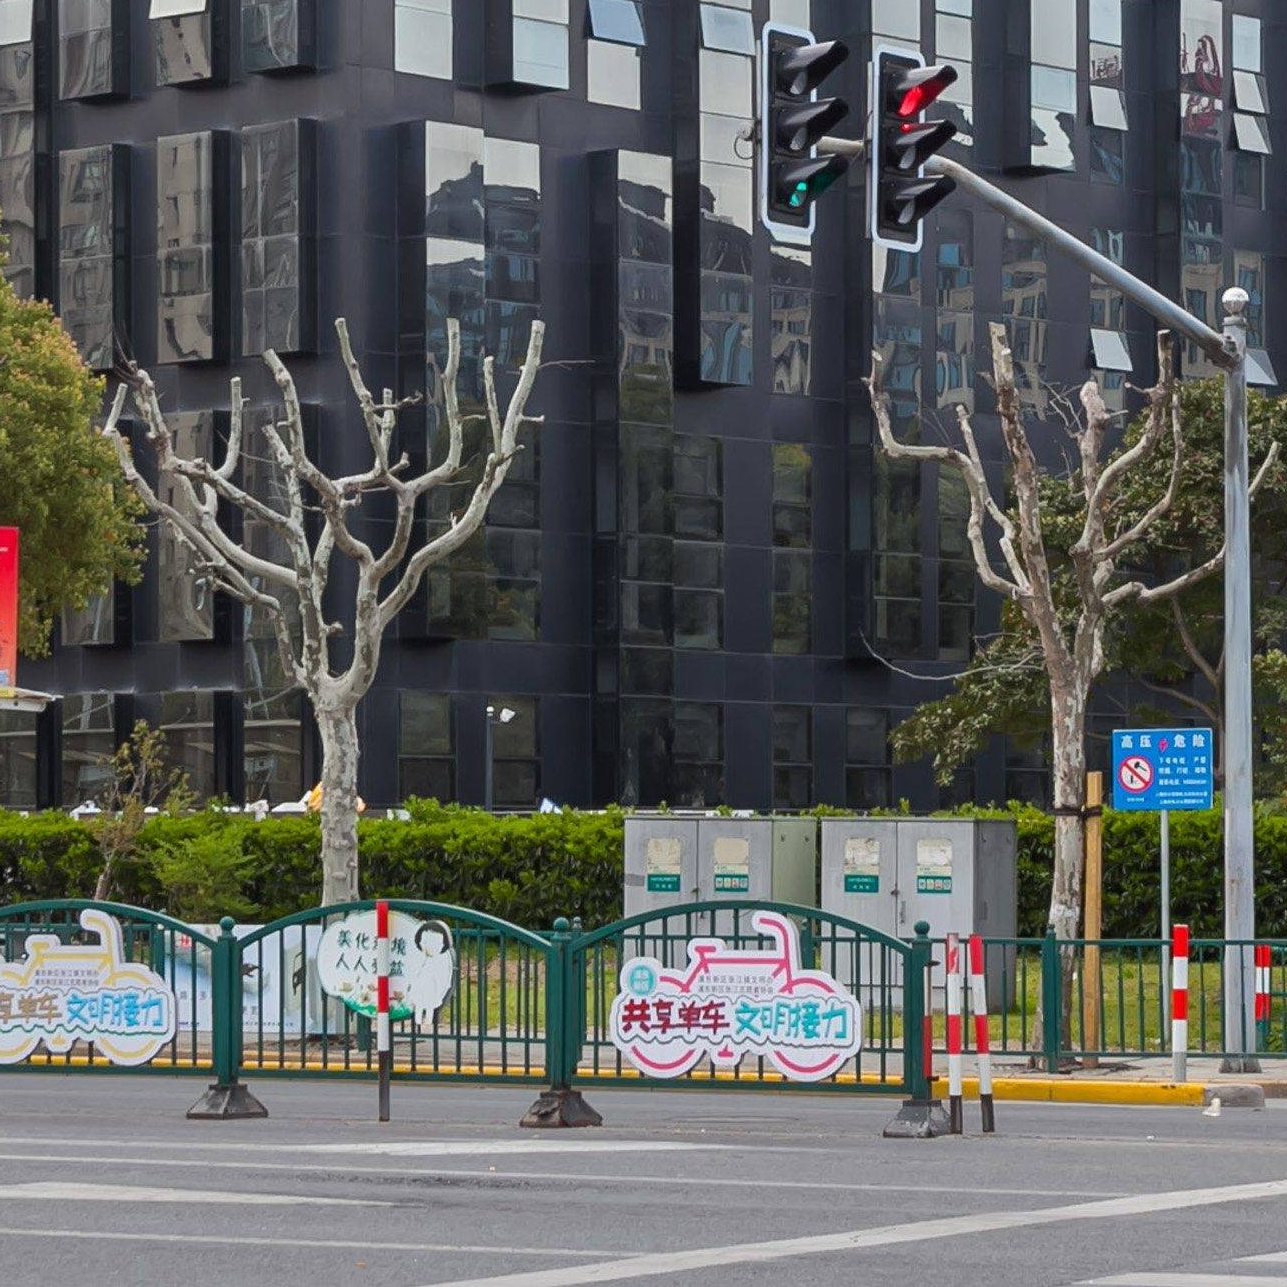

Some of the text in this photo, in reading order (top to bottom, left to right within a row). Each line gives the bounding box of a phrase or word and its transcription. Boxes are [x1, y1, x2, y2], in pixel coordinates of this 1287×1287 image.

[66, 993, 163, 1027] 文明接力
[622, 999, 847, 1039] 共享单车 文明接力
